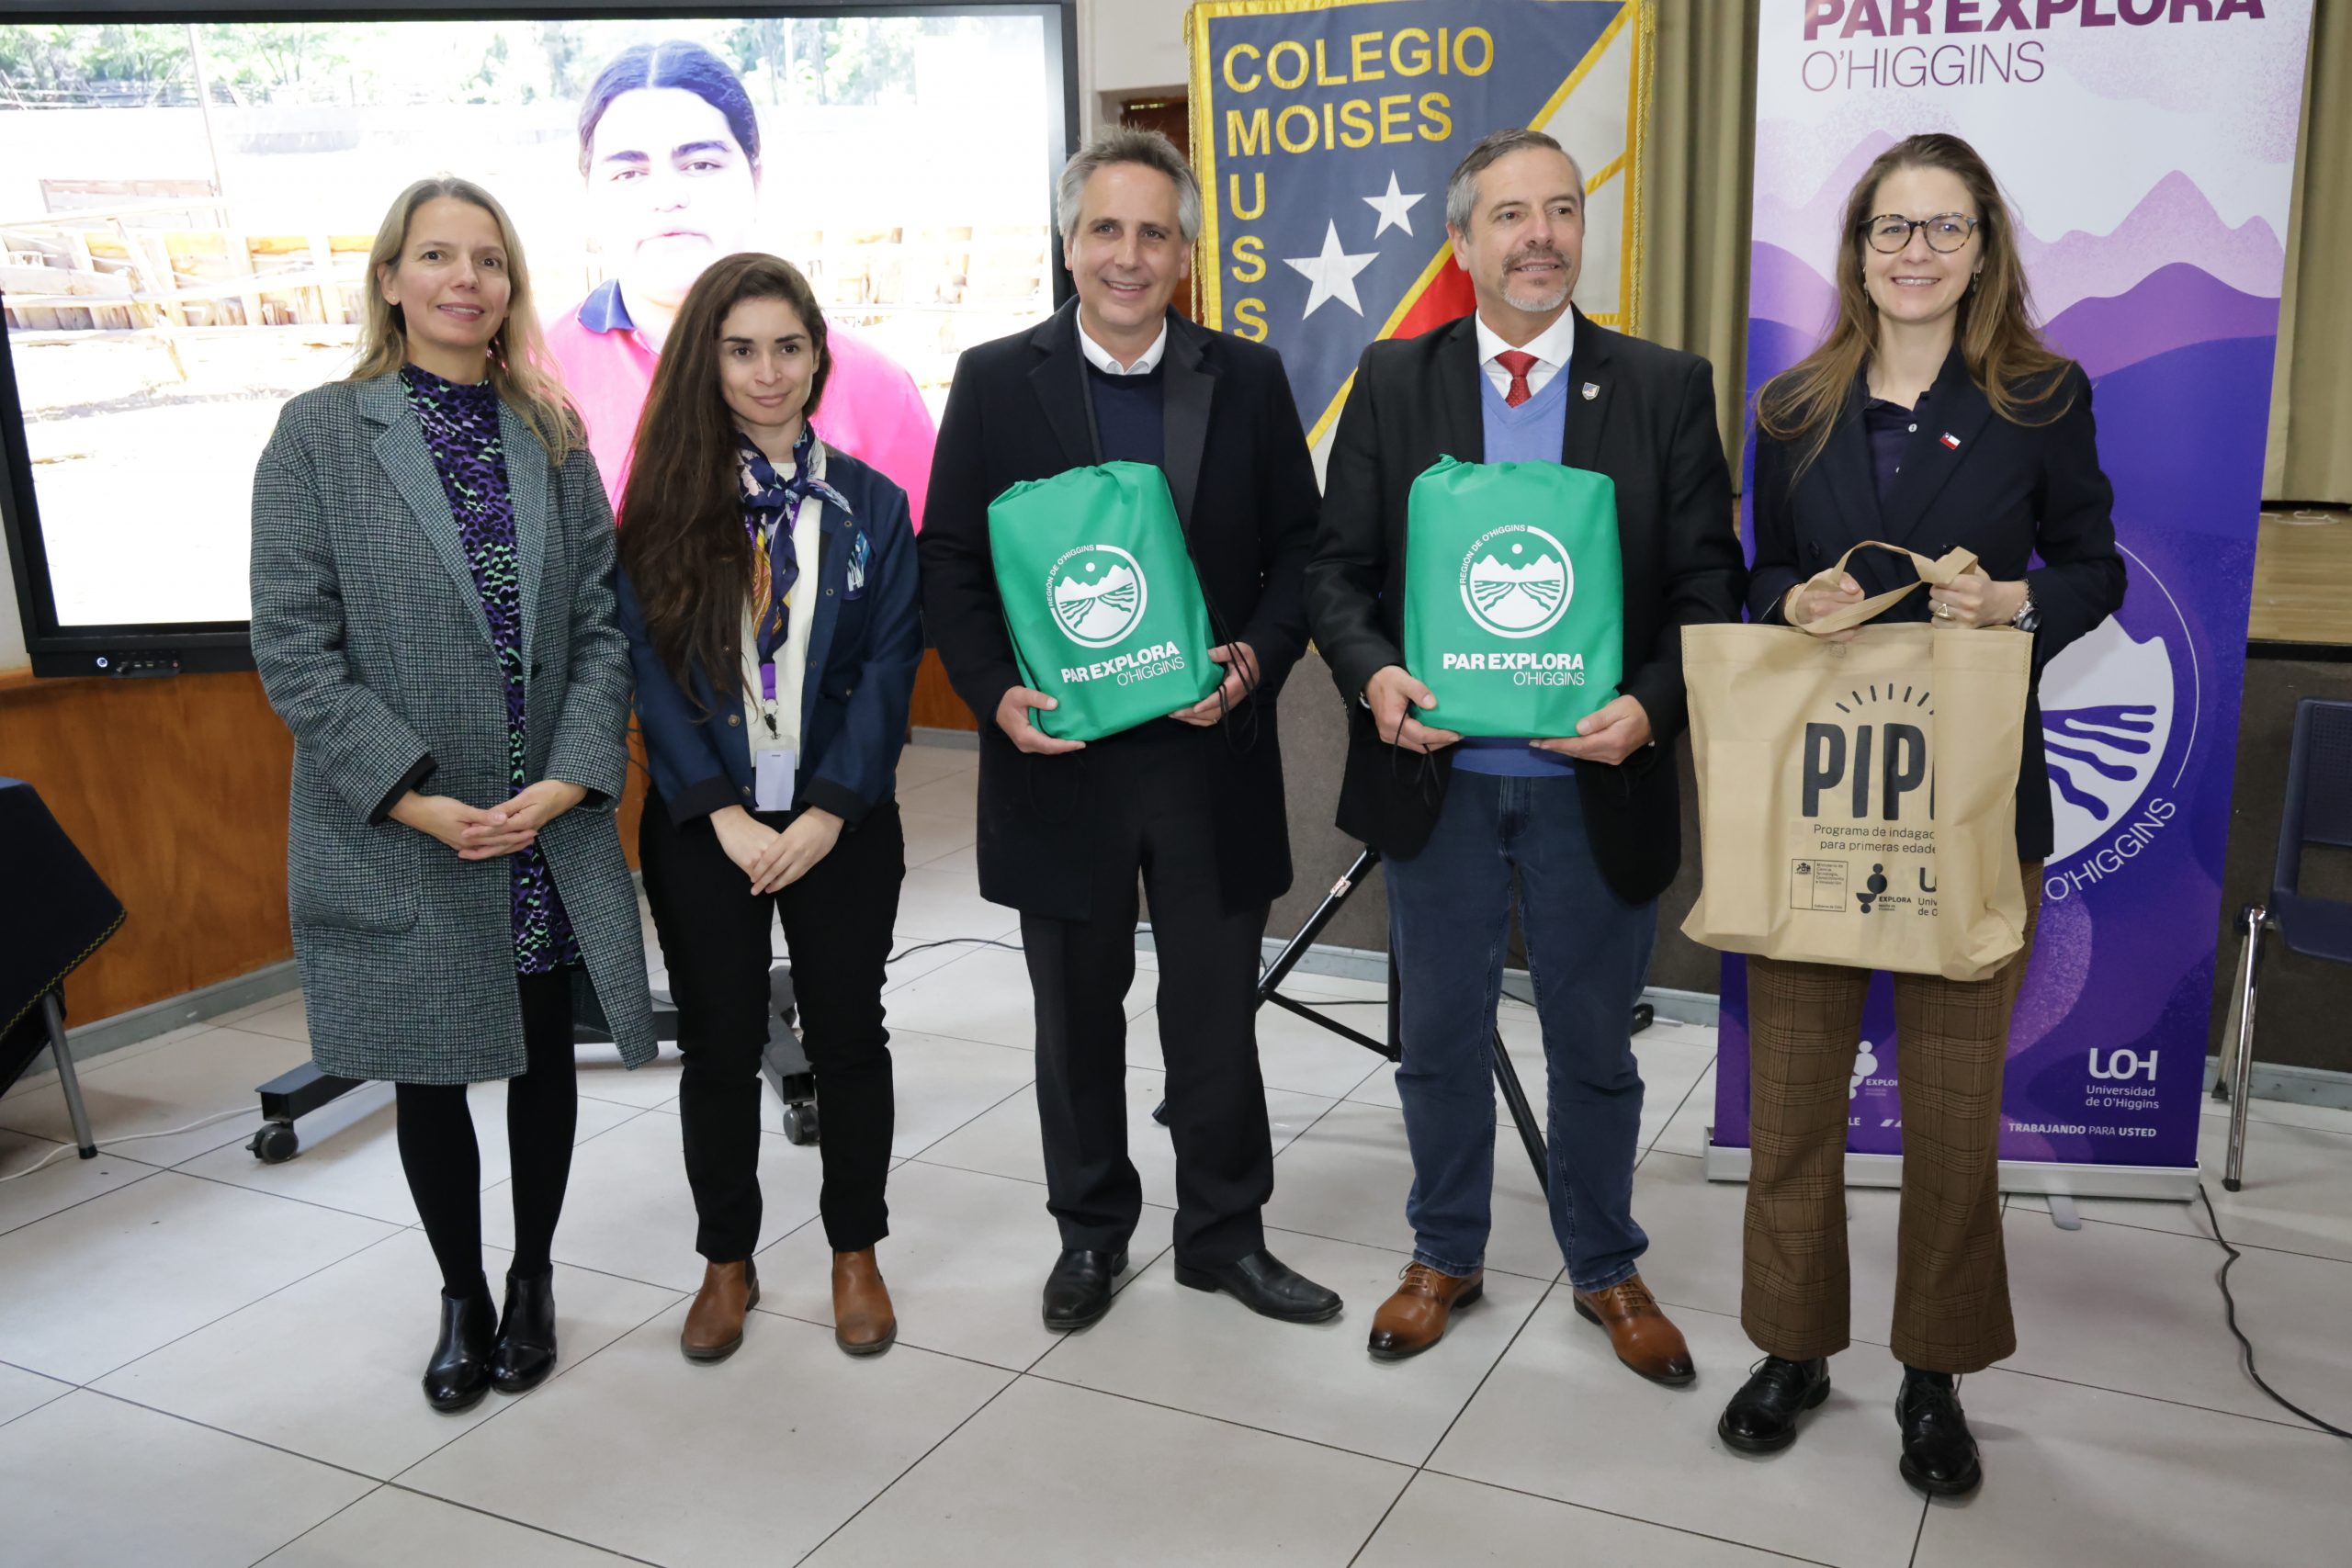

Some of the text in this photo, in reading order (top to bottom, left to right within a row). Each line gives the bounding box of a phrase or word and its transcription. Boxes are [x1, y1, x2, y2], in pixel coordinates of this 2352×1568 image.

[1804, 0, 1931, 40] PAR
[1223, 26, 1494, 93] COLEGIO
[1802, 40, 2044, 92] O'HIGGINS
[1227, 92, 1453, 157] MOISES
[1471, 539, 1483, 551] DE
[1482, 524, 1526, 541] O'HIGGINS
[1049, 564, 1059, 576] DE
[1057, 544, 1094, 565] O'HIGGINS
[1060, 641, 1180, 682] PAR EXPLORA
[1116, 656, 1185, 686] O'HIGGINS
[1442, 653, 1584, 670] PAR EXPLORA
[1513, 671, 1585, 686] O'HIGGINS
[1802, 722, 1935, 820] PIP
[1814, 824, 1869, 836] Programa
[1871, 827, 1886, 837] de
[1820, 840, 1846, 850] para
[1849, 840, 1899, 852] primeras
[2045, 797, 2176, 900] O'HIGGINS
[1917, 908, 1929, 916] de
[1866, 1078, 1898, 1087] EXPLO
[2086, 1085, 2156, 1097] Universidad
[2085, 1097, 2159, 1111] de O'Higgins
[2008, 1122, 2157, 1138] TRABAJANDO PARA USTED
